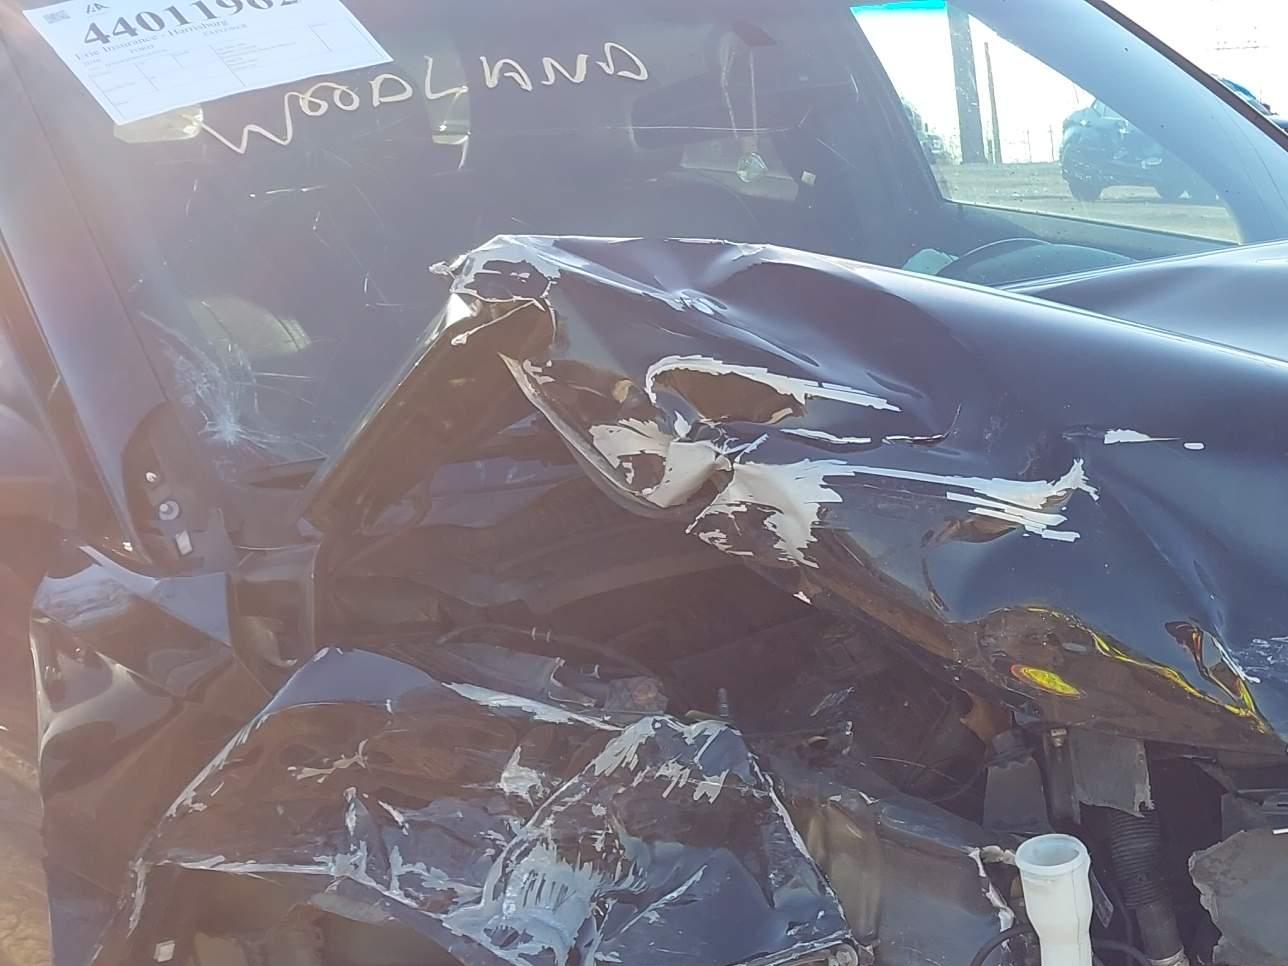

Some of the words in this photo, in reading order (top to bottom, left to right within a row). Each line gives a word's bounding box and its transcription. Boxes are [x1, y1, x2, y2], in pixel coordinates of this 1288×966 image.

[102, 34, 158, 53] Insurance
[167, 19, 229, 36] Harrisburg
[198, 42, 649, 154] WOODLAND
